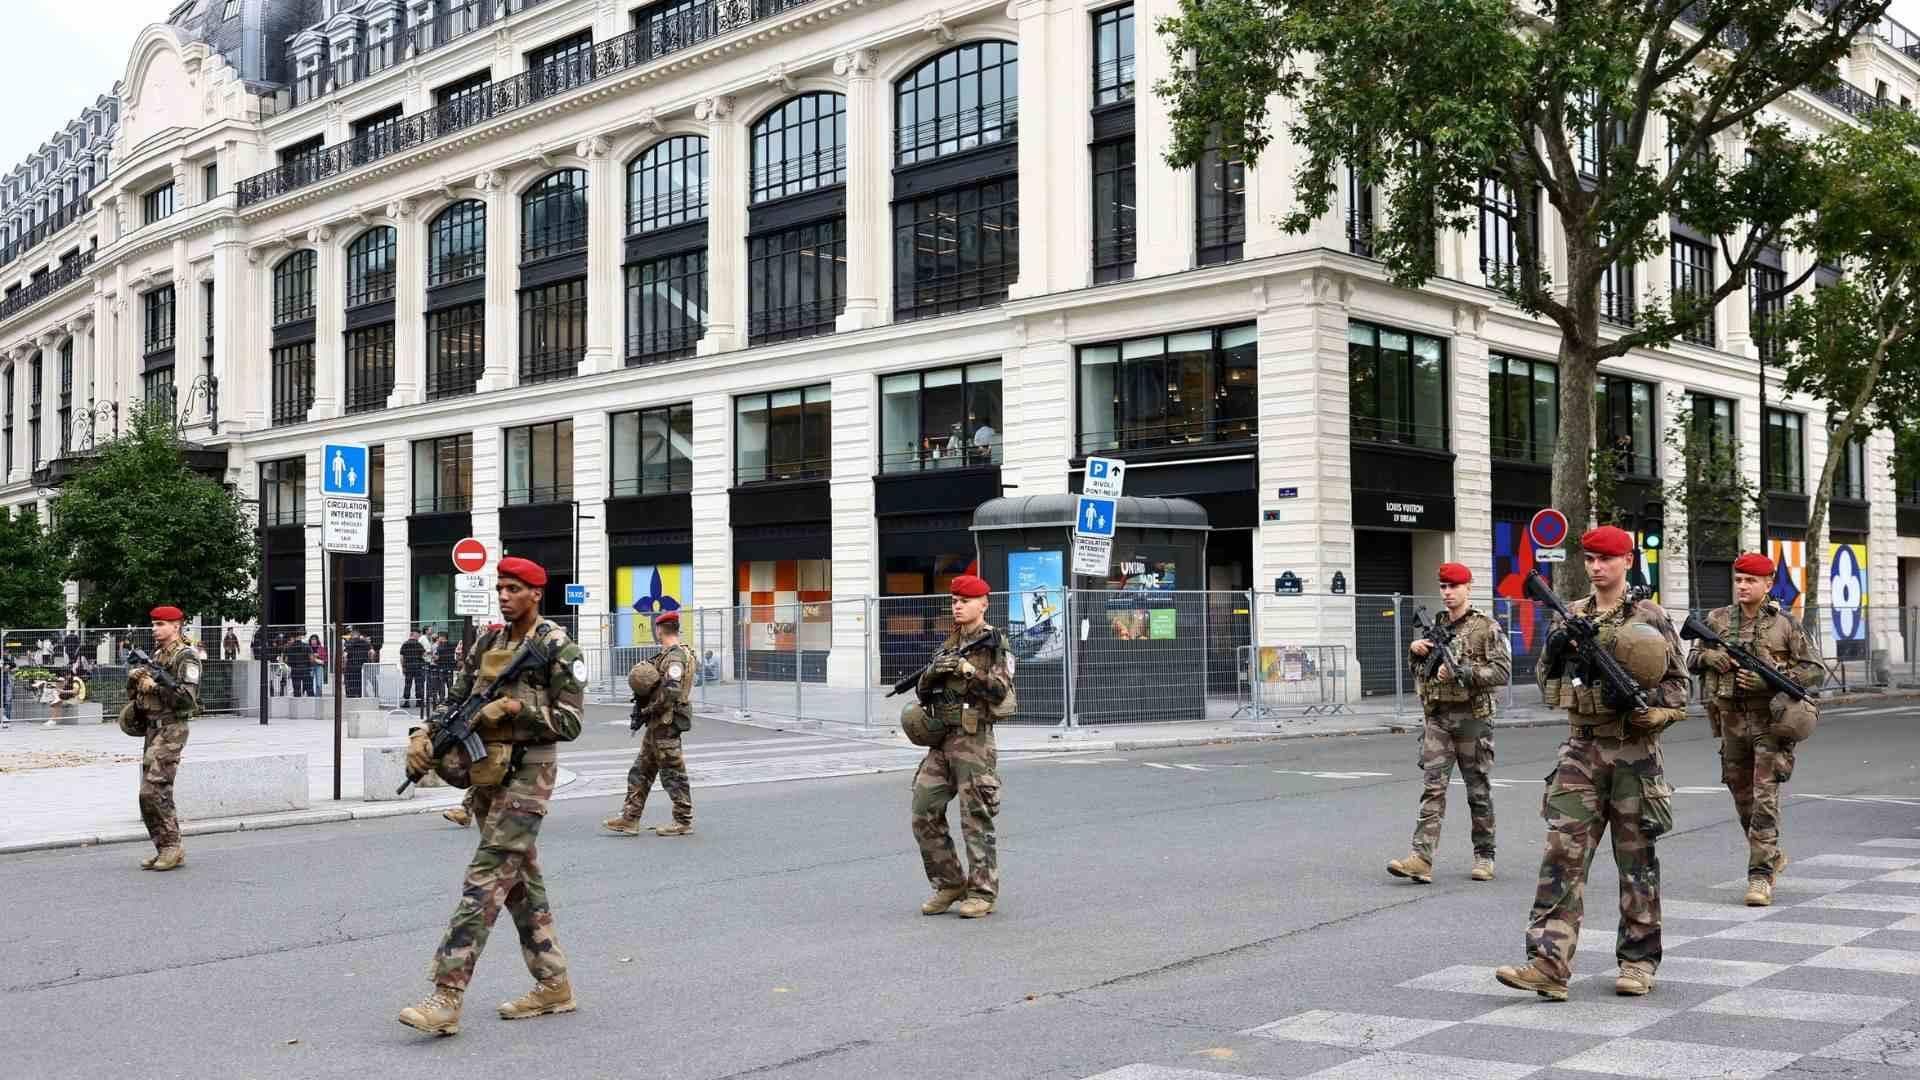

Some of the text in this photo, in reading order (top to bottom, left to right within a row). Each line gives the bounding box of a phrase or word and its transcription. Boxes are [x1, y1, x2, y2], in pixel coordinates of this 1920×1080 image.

[1094, 463, 1104, 476] P
[1092, 480, 1114, 488] RIVOLI
[327, 500, 368, 510] CIRCULATION
[1386, 502, 1424, 513] LOUIS VUITTON
[330, 510, 362, 519] INTERDITE
[1400, 514, 1417, 522] DREAM
